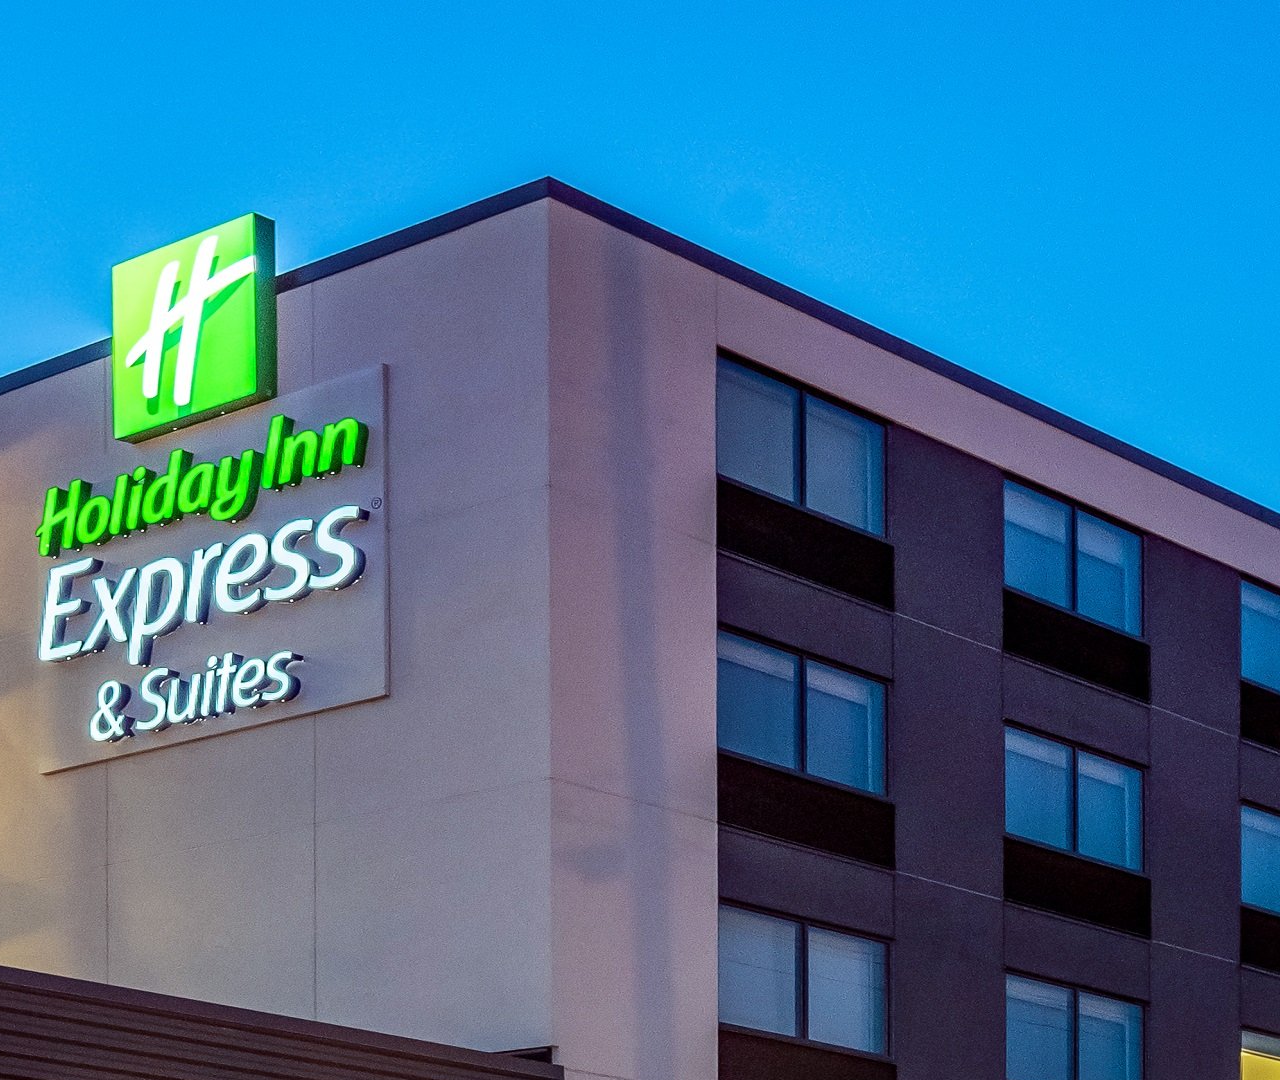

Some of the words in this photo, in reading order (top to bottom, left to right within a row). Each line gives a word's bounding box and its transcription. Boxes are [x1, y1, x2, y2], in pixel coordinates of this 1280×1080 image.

[125, 235, 257, 407] H
[35, 448, 258, 557] Holiday
[261, 414, 364, 491] Inn
[38, 505, 365, 666] Express
[89, 680, 125, 743] &
[135, 650, 297, 733] Suites
